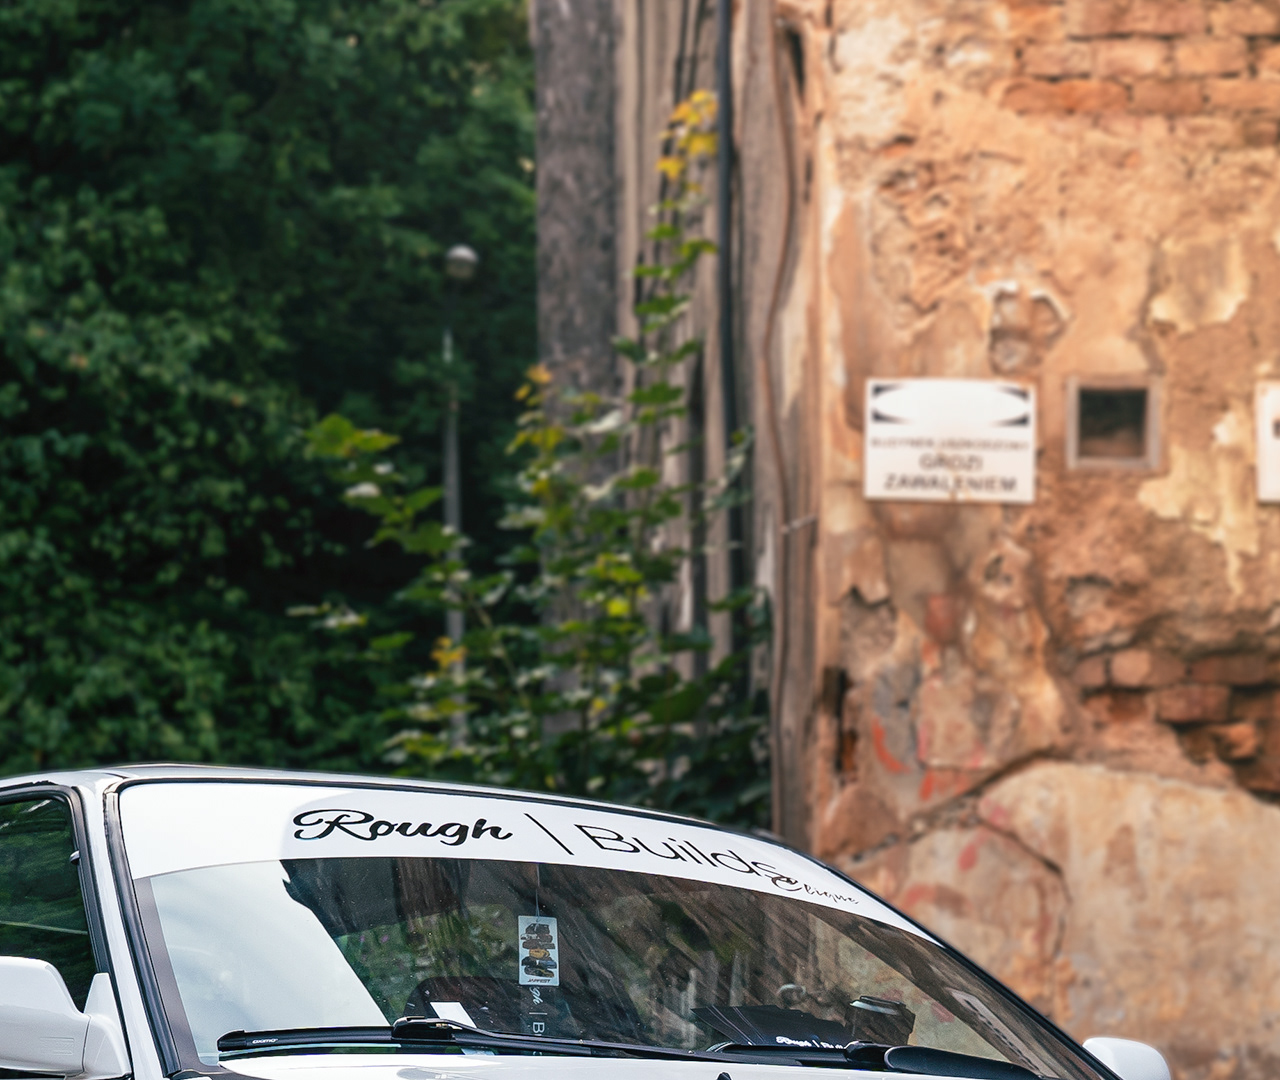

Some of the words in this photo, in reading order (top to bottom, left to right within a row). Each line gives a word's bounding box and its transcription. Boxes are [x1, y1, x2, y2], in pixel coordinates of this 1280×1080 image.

[884, 473, 1017, 492] ZAWALENIEM
[292, 808, 514, 845] Rough
[574, 823, 786, 880] Builds
